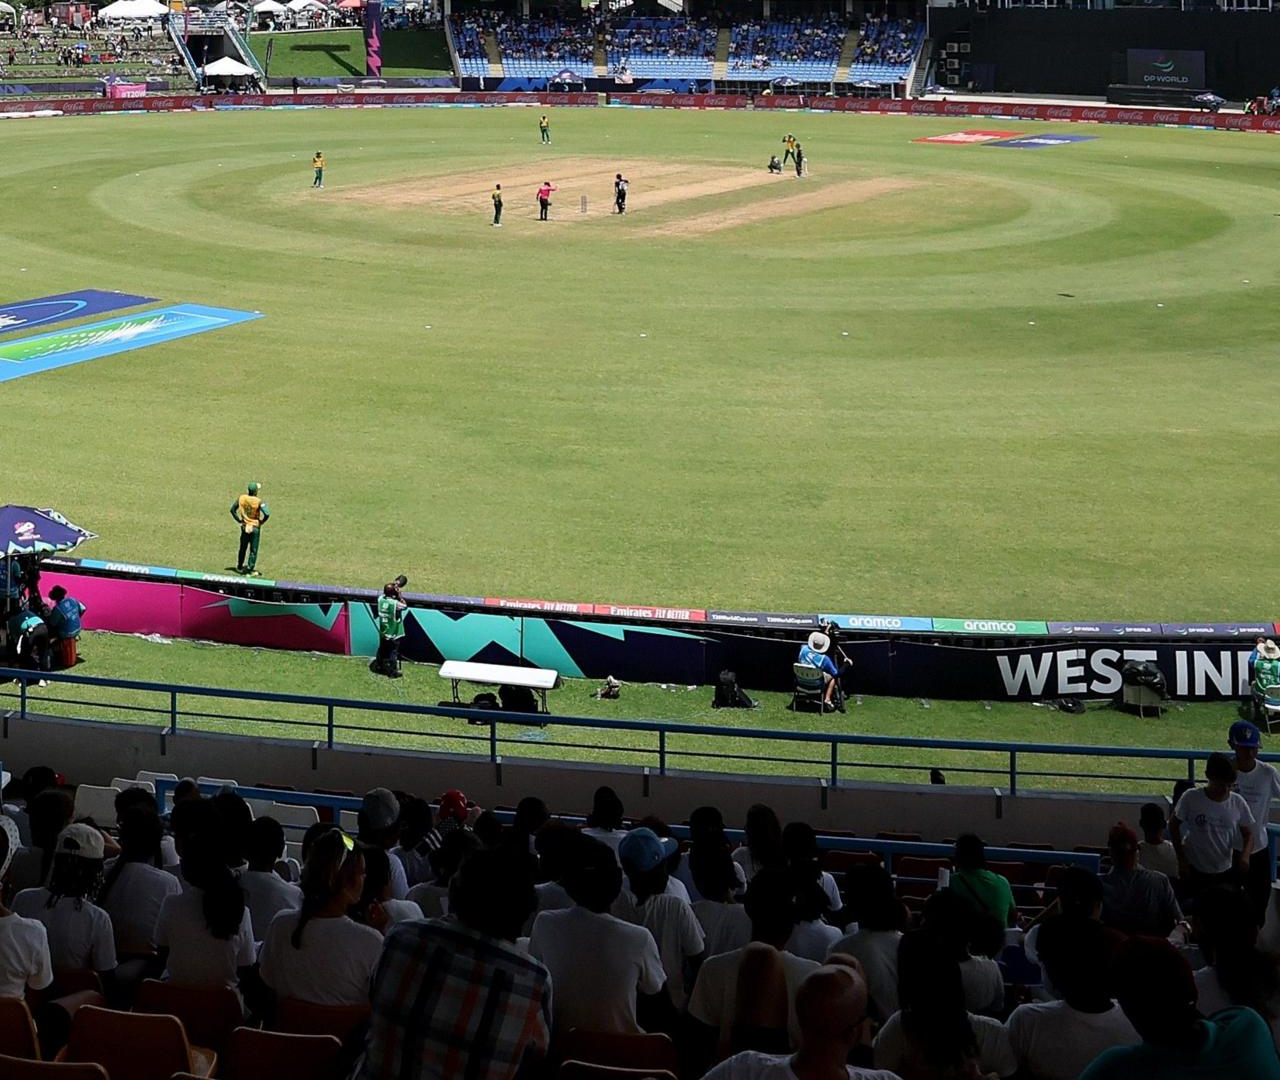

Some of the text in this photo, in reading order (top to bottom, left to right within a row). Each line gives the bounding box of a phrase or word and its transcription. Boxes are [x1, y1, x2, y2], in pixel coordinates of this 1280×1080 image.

[1144, 74, 1188, 83] DP WORLD
[500, 600, 542, 610] Emirates
[610, 606, 690, 620] Emirates FLY BETTER
[849, 617, 902, 628] aramco
[964, 620, 1016, 632] aramco
